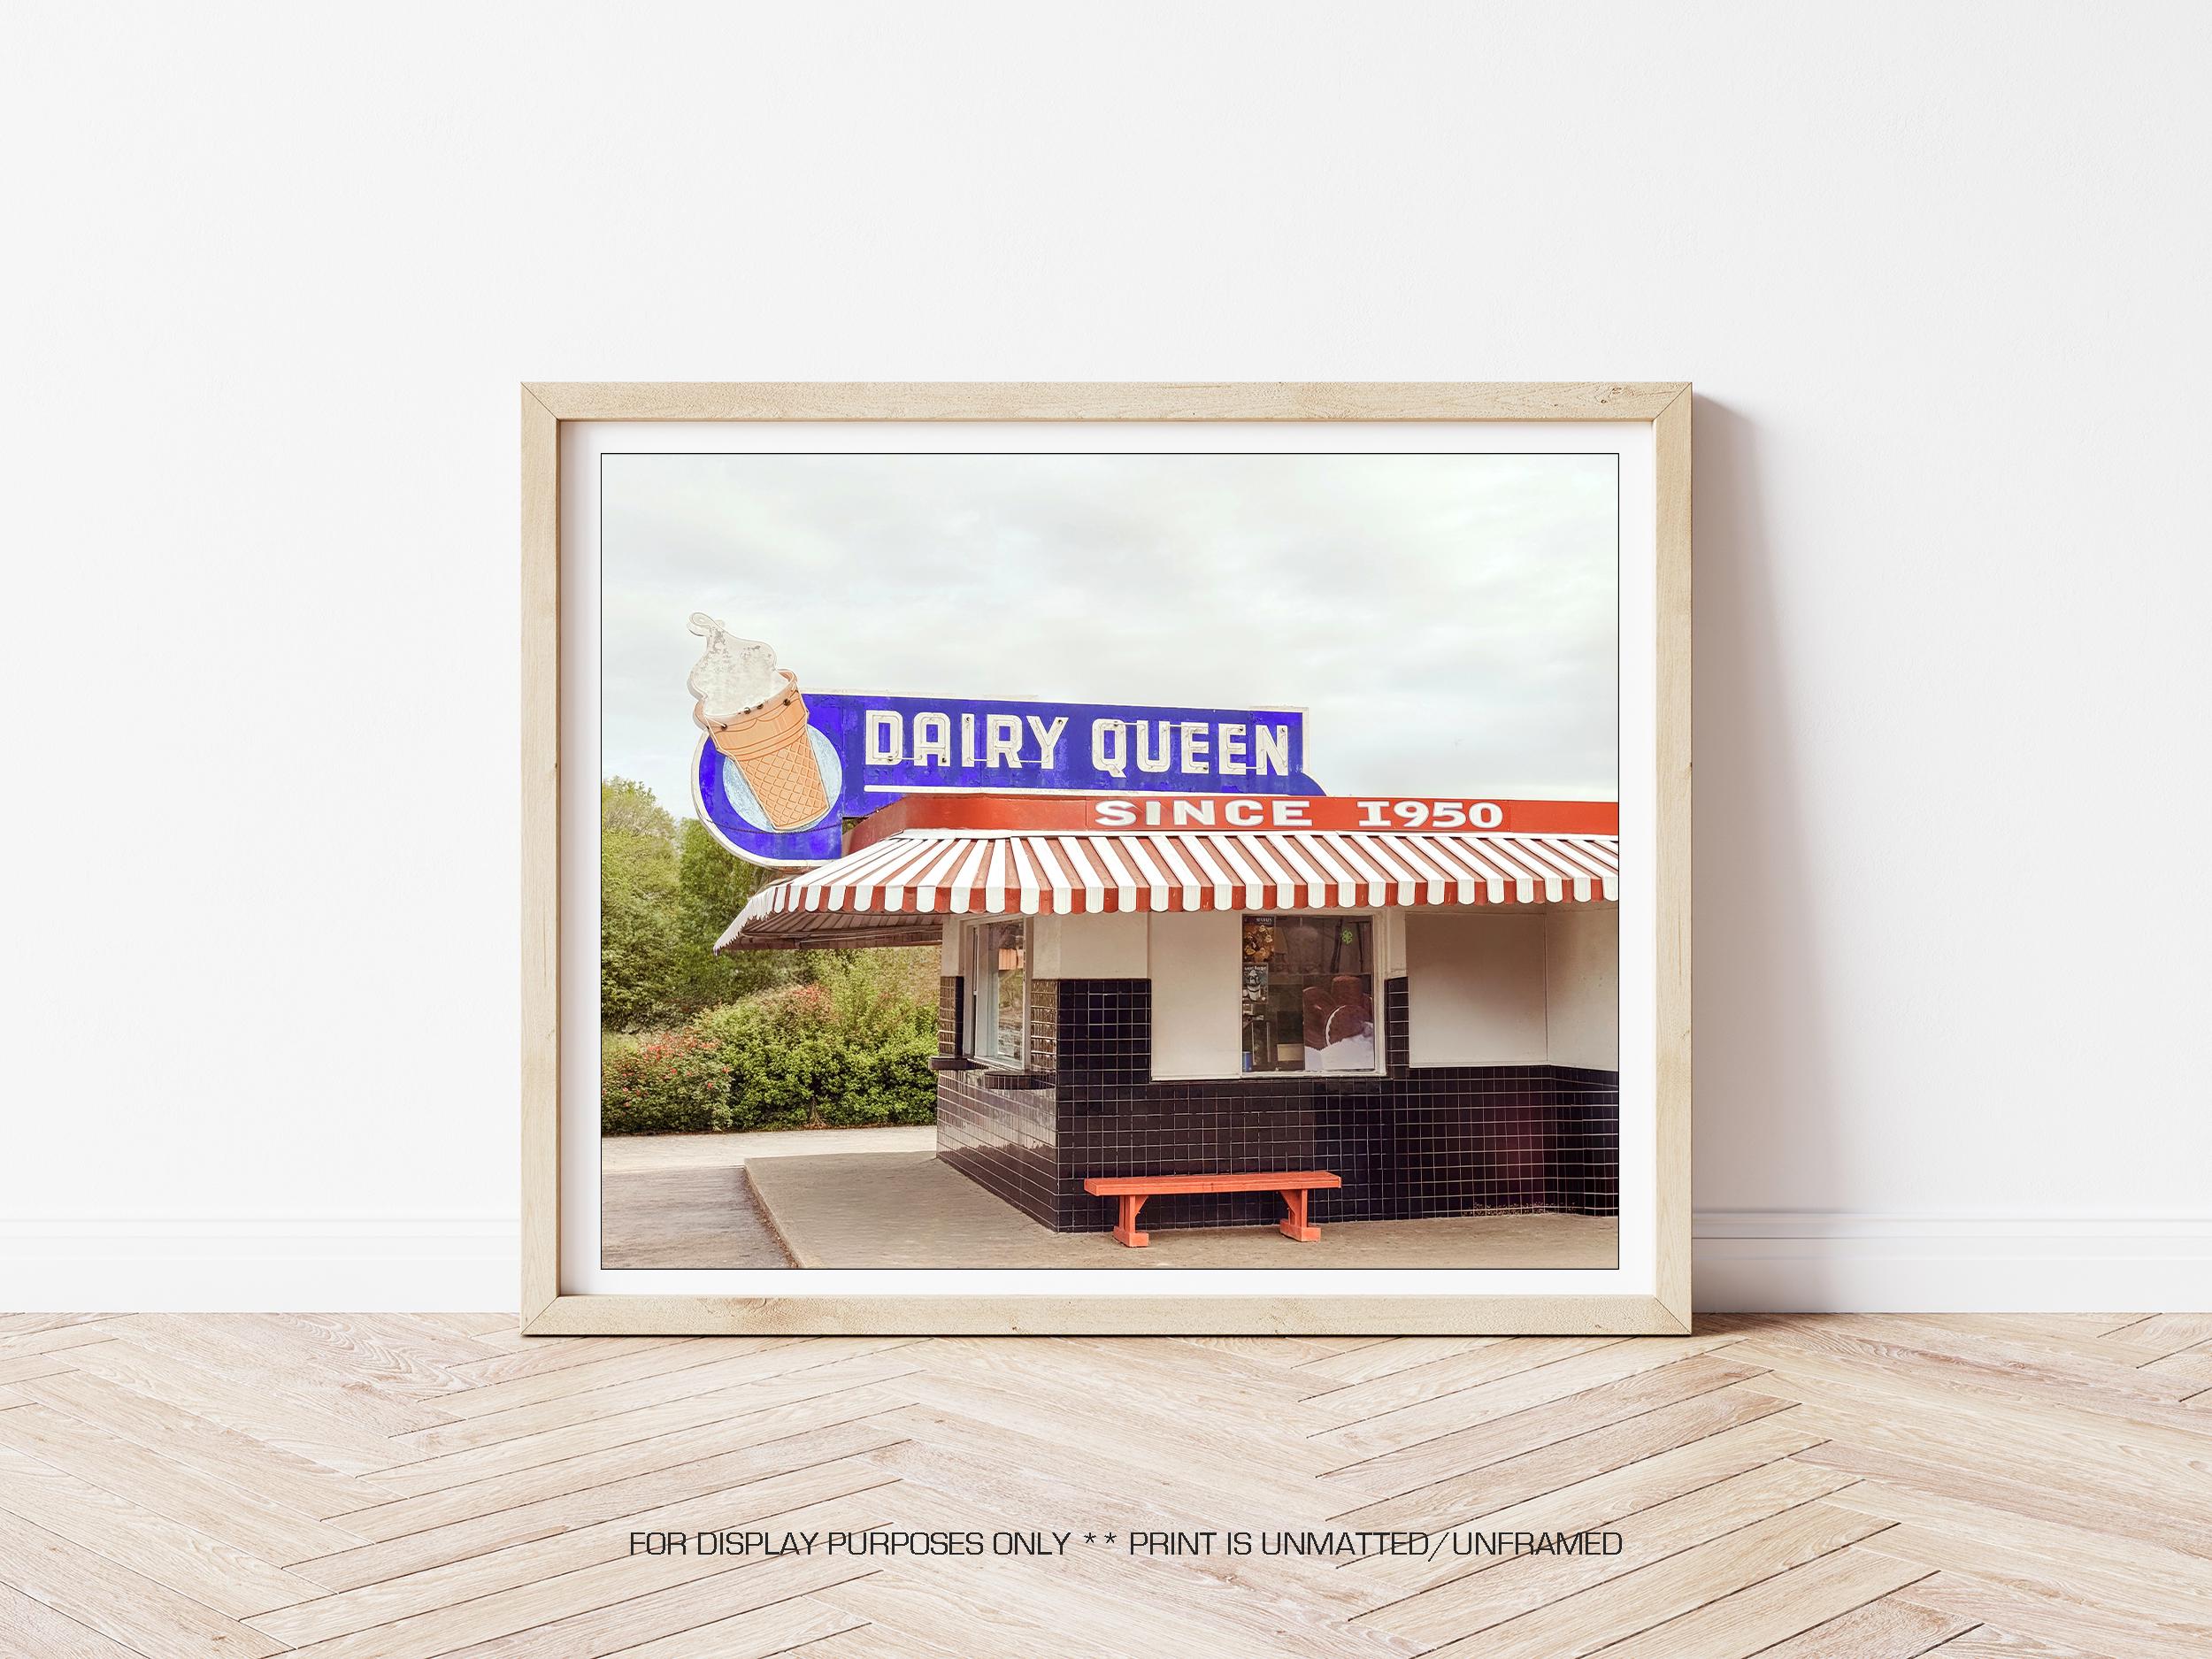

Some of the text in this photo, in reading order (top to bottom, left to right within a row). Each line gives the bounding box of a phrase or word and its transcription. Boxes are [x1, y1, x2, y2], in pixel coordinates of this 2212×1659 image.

[864, 709, 1290, 778] DAIRY QUEEN
[1094, 799, 1313, 827] SINCE
